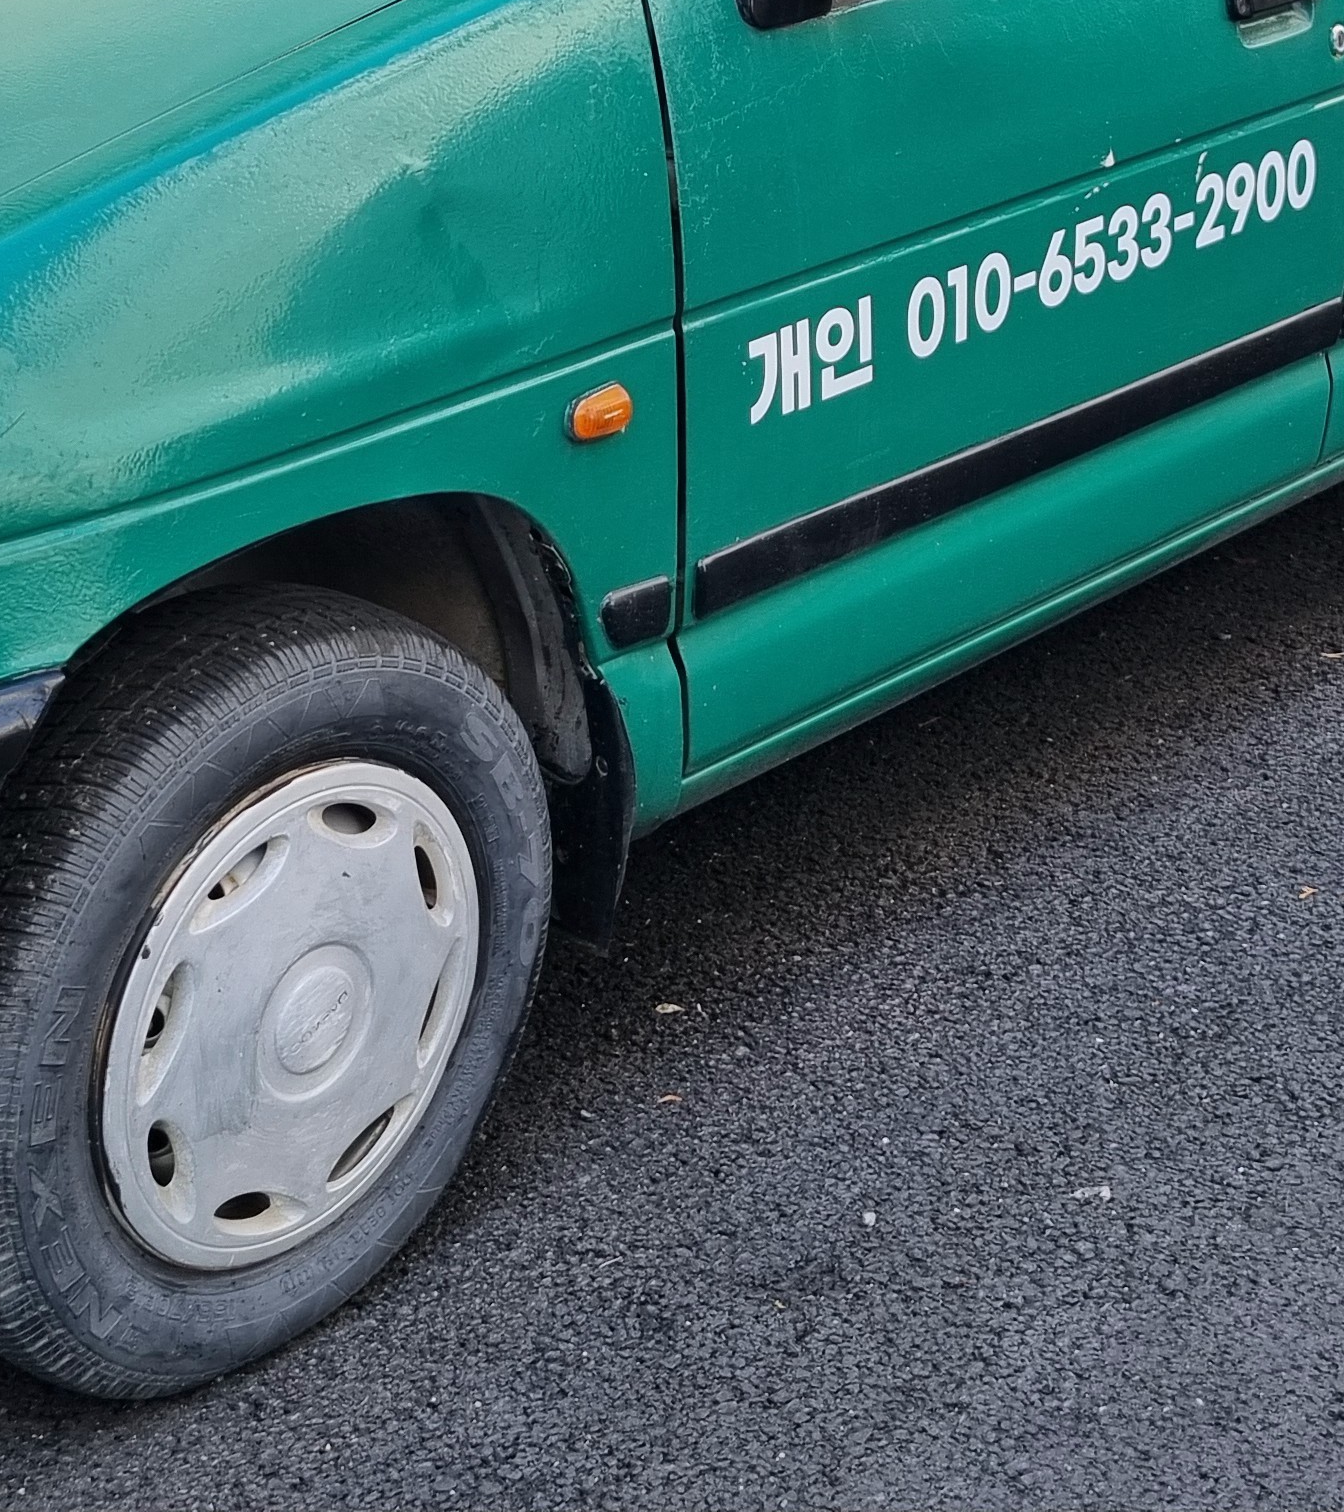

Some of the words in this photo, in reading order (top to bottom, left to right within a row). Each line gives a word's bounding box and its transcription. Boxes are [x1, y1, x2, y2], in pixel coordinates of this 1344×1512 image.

[748, 295, 873, 425] 개인
[907, 138, 1317, 358] 010-6533-2900
[29, 985, 124, 1341] NEXEN
